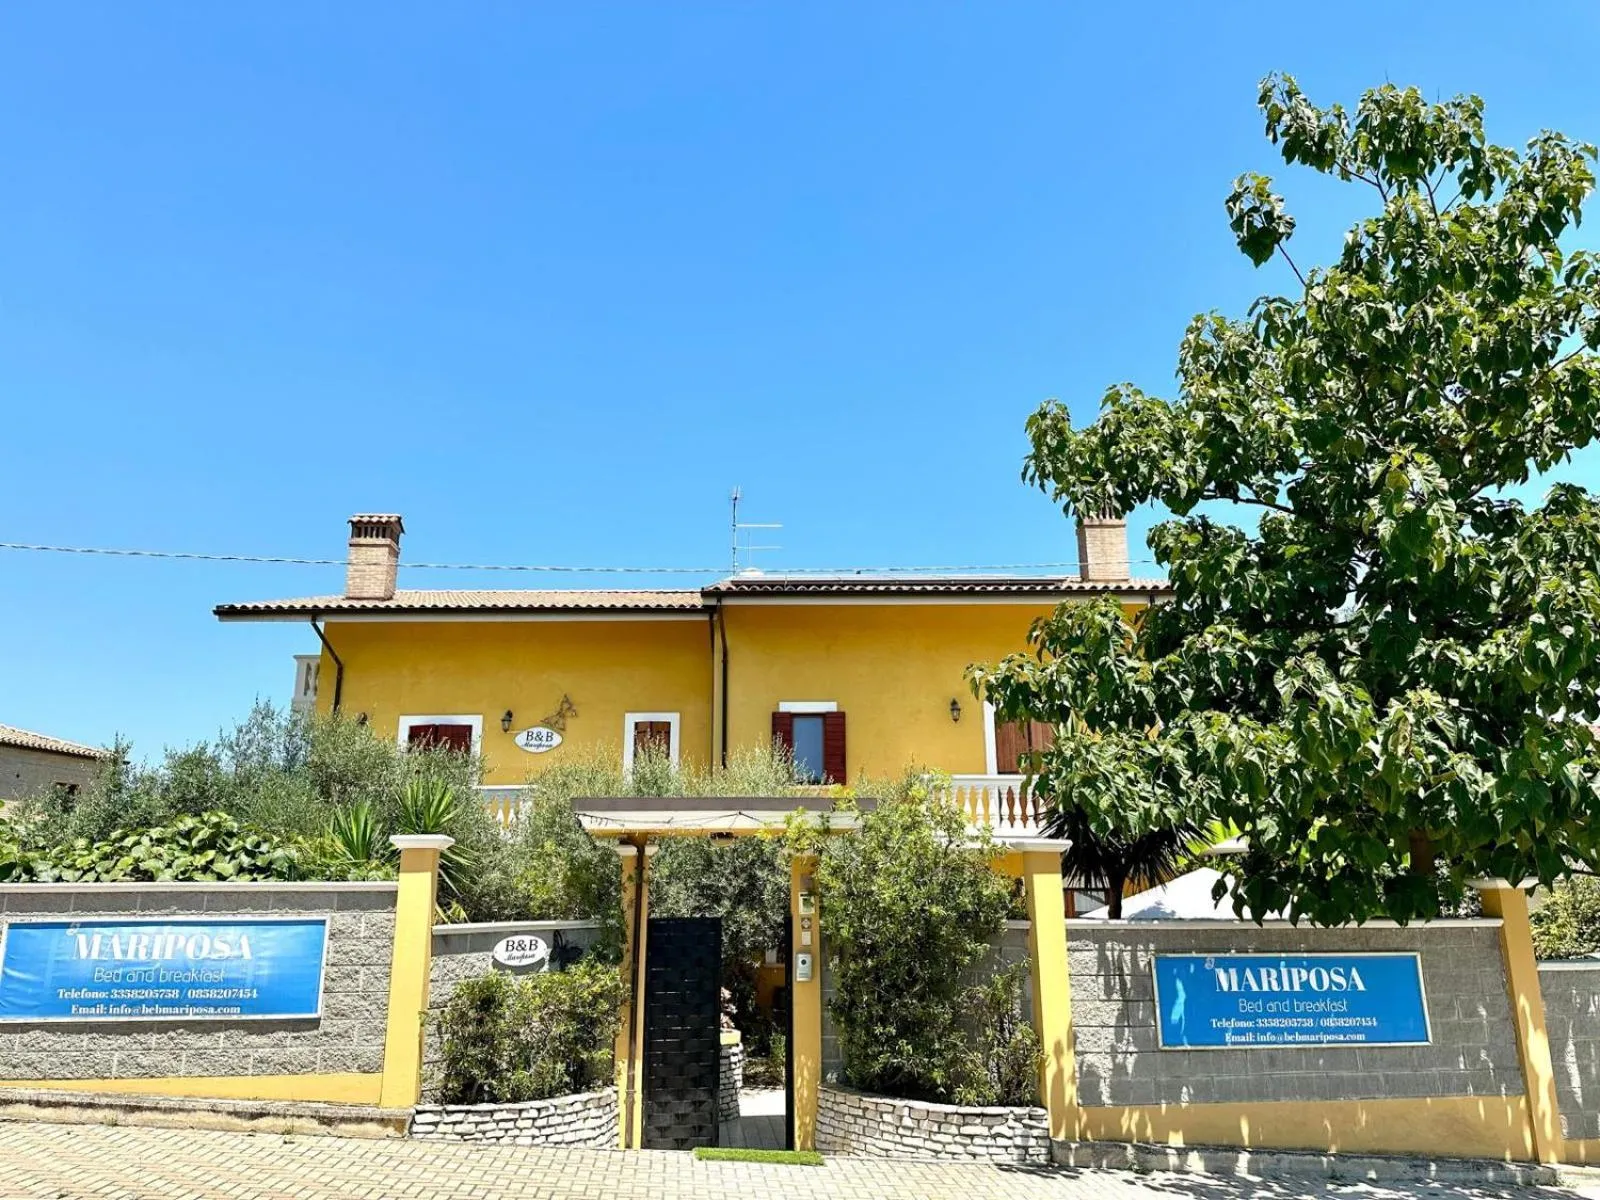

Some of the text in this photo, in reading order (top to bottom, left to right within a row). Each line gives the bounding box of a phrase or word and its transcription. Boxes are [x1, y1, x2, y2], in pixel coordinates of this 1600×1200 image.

[526, 730, 554, 742] B&B
[72, 931, 252, 961] MARIPOSA
[505, 938, 539, 952] B&B
[94, 966, 225, 983] Bed and breakfast
[1215, 966, 1367, 992] MARIPOSA
[57, 987, 109, 999] Telefono:
[71, 1003, 108, 1015] Email:
[1239, 998, 1348, 1013] Bed and breakfast
[1210, 1017, 1255, 1029] Telefono:
[1225, 1032, 1256, 1043] Email:
